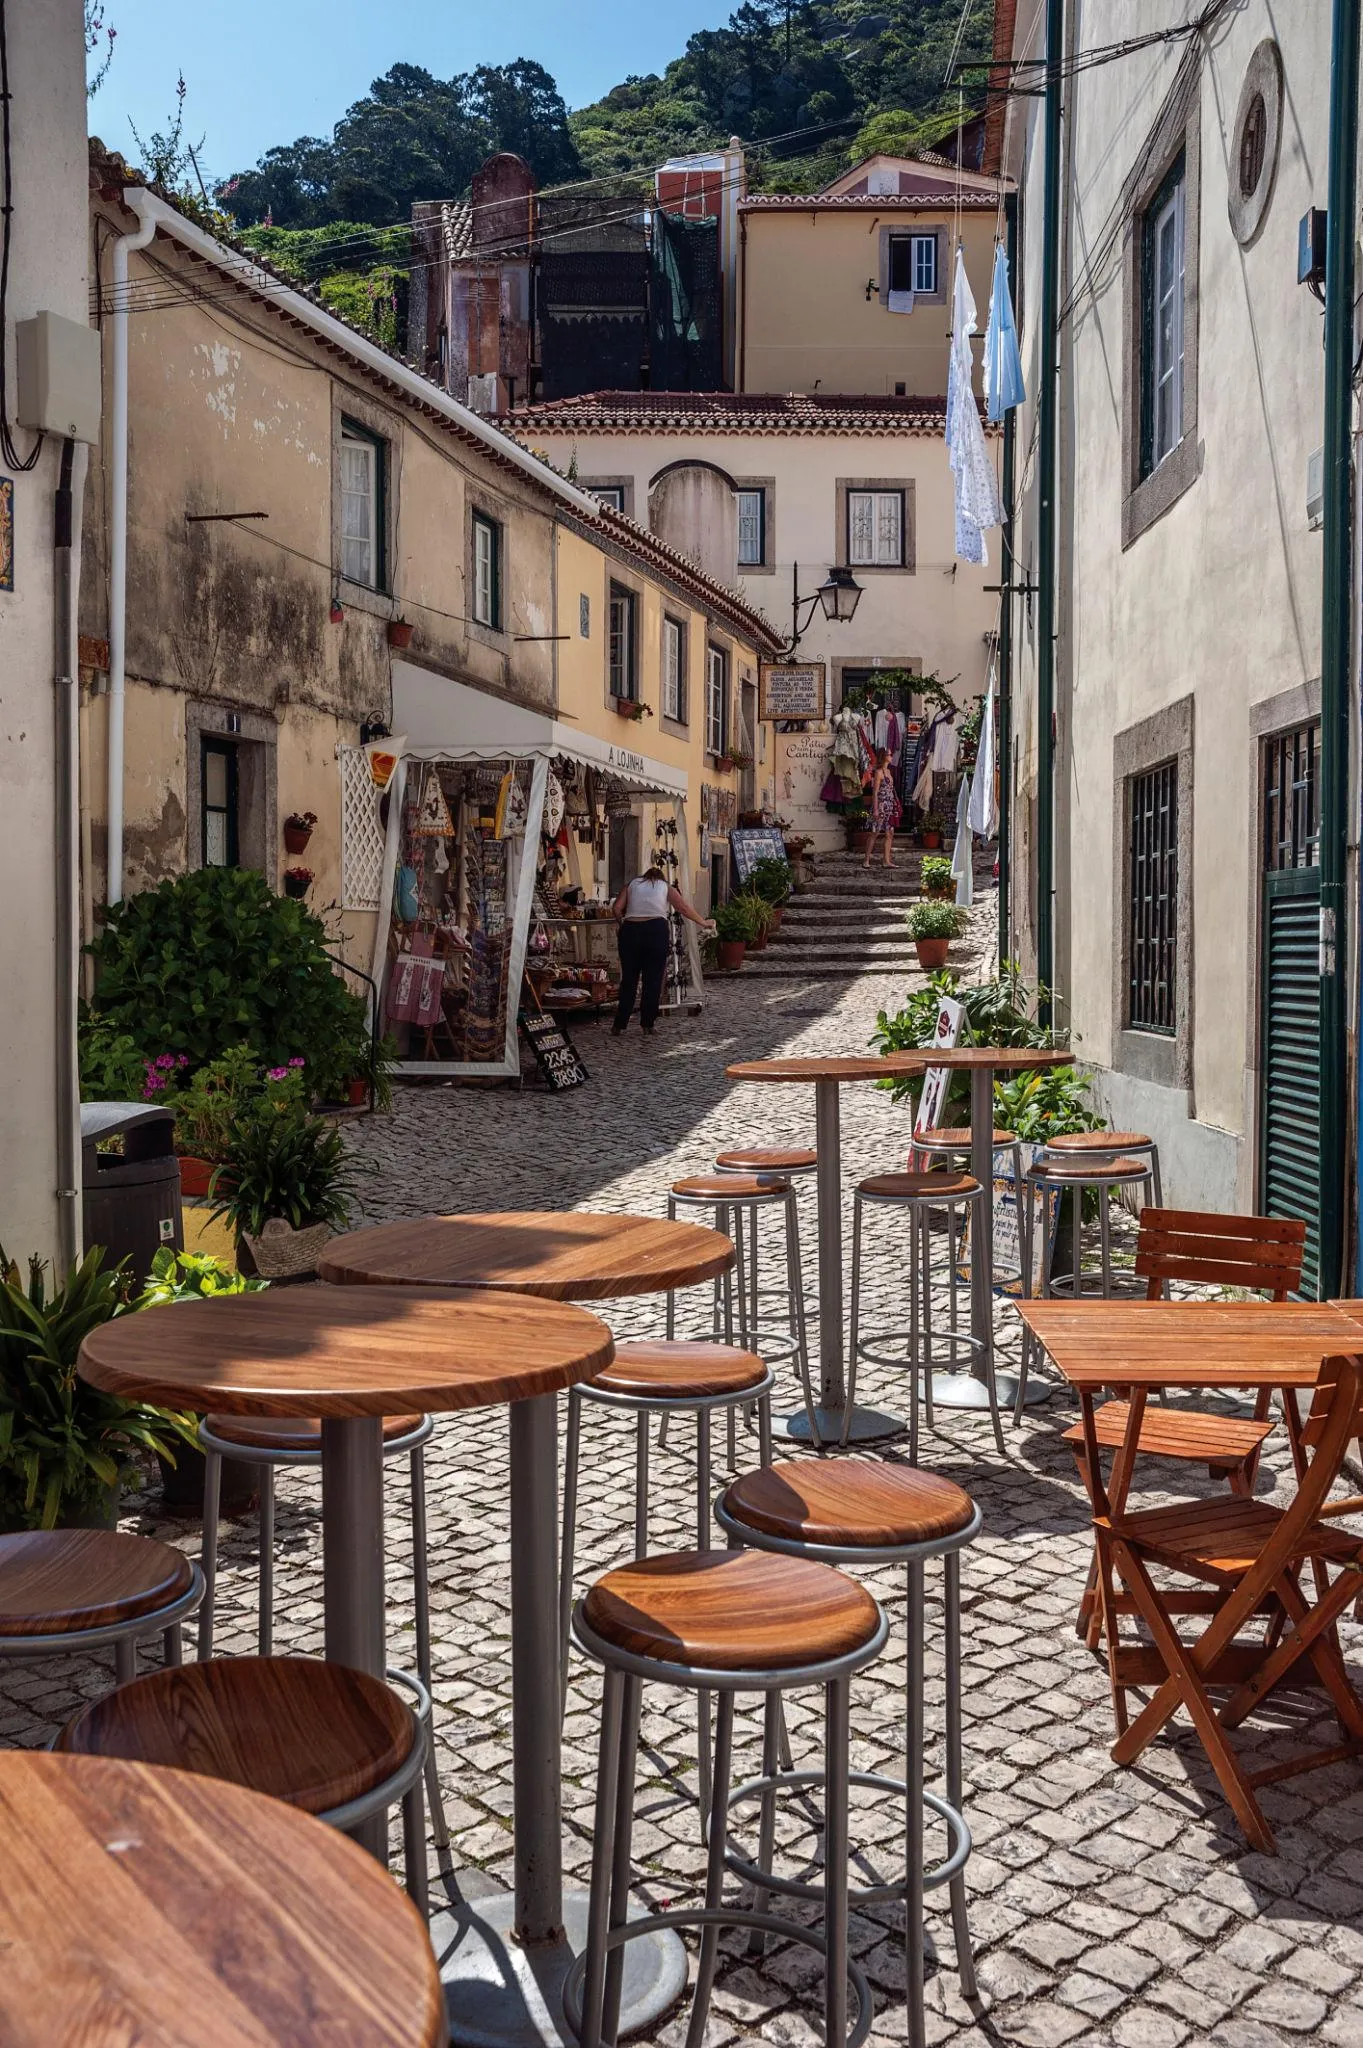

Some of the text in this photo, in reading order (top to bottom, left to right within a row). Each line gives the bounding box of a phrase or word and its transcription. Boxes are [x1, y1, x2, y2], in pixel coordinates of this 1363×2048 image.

[233, 713, 237, 732] 1
[608, 746, 644, 773] A LOJINHA
